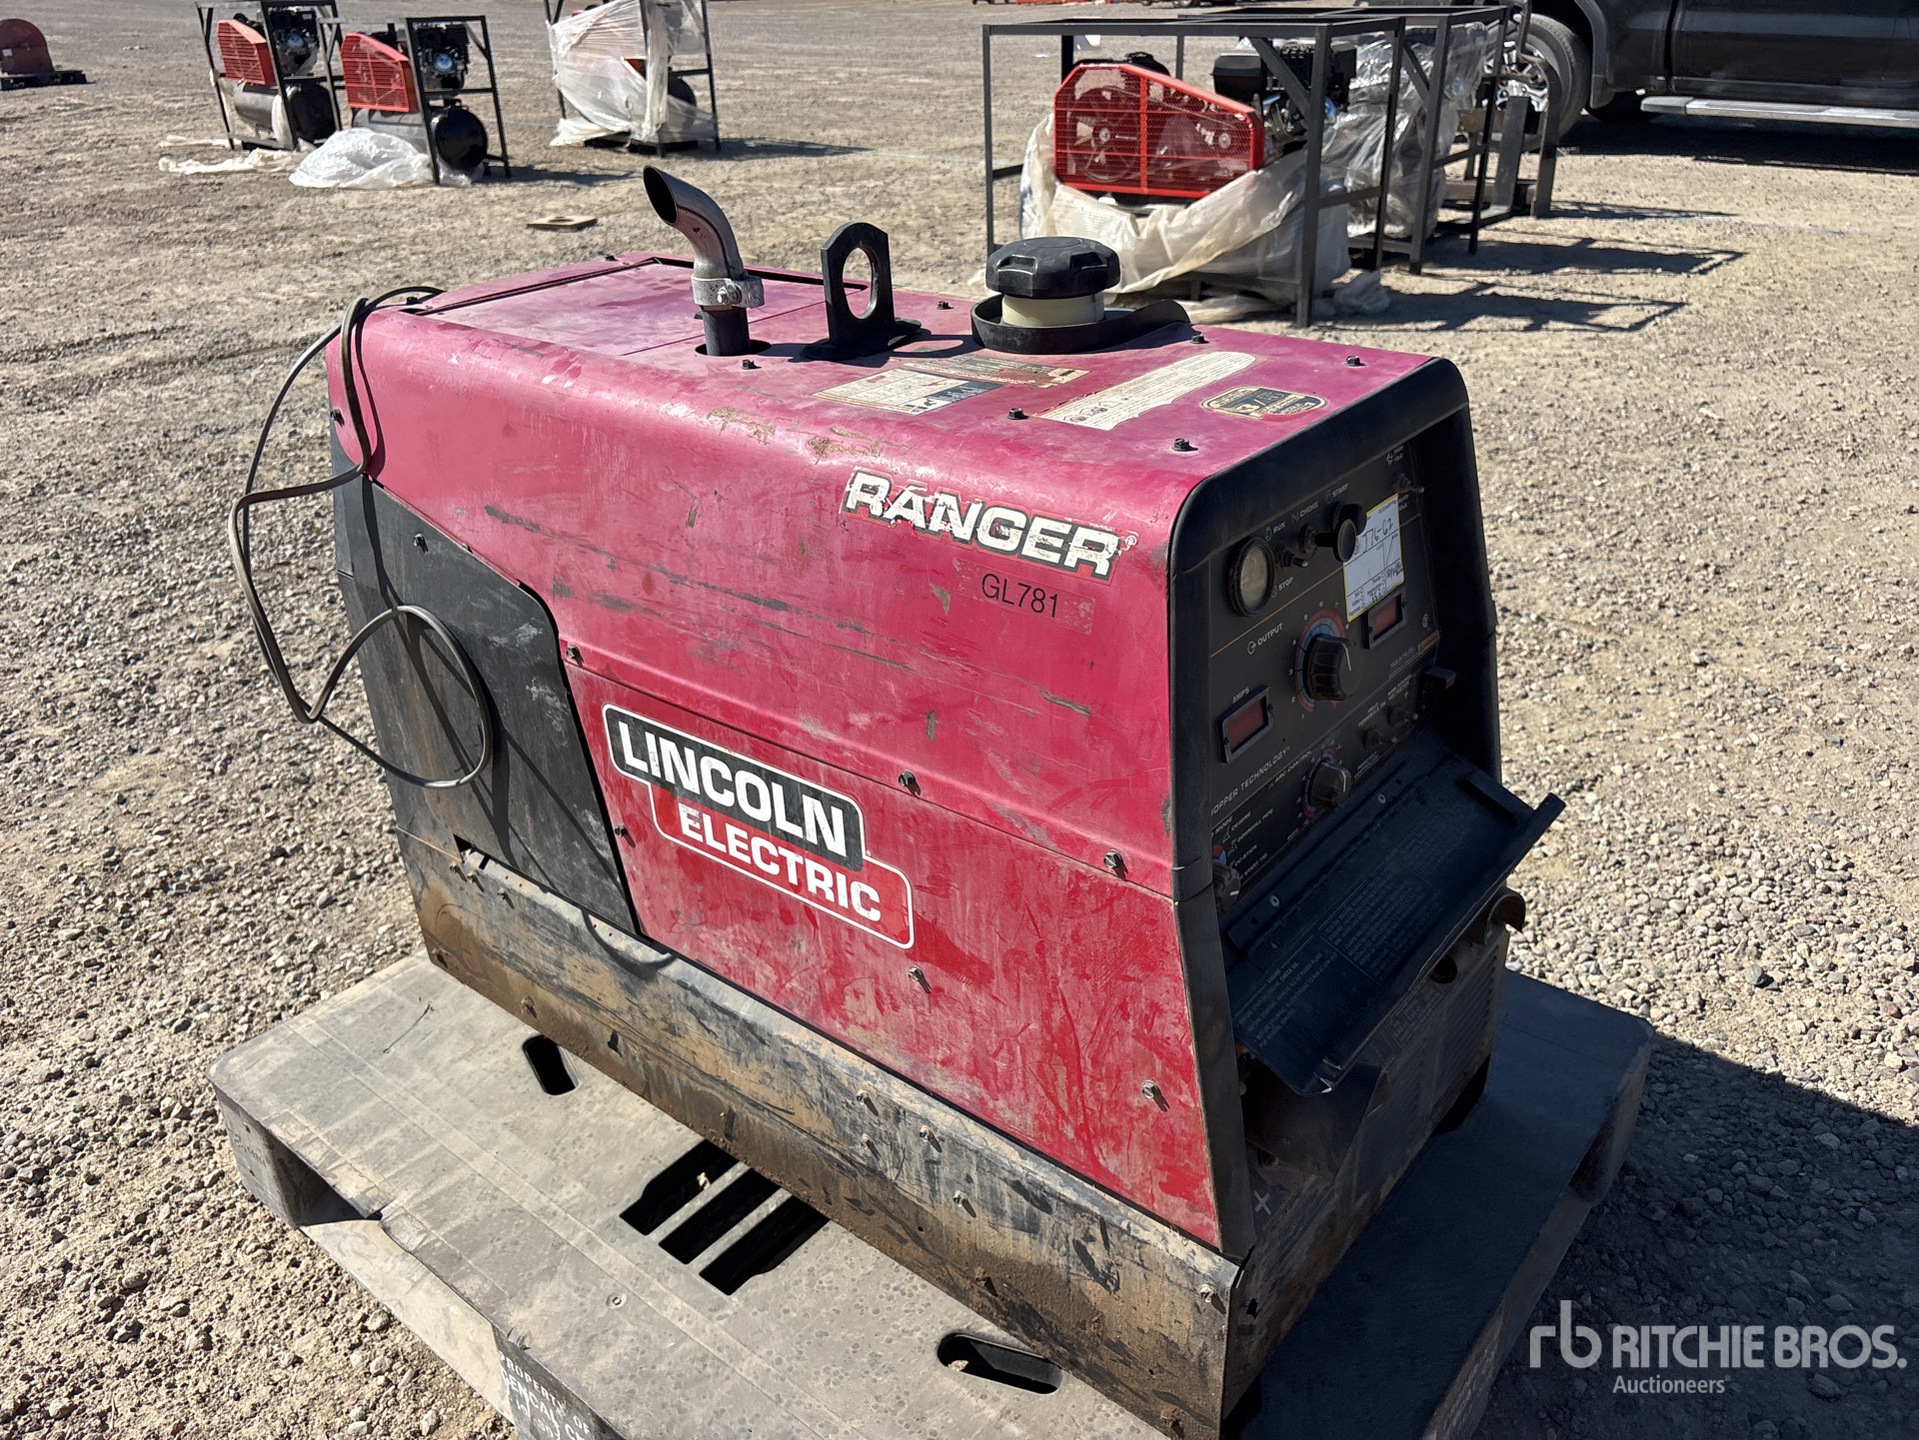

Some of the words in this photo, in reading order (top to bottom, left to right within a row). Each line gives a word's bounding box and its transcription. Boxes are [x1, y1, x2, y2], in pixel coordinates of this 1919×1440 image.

[1300, 501, 1319, 517] CHOKE
[845, 470, 1121, 577] RANGER
[1273, 521, 1286, 533] RUN
[1278, 577, 1293, 591] STOP
[981, 573, 1058, 618] GL781
[1257, 622, 1283, 646] OUTPUT
[1232, 686, 1250, 703] AMPS
[618, 721, 847, 857] LINCOLN
[678, 803, 881, 921] ELECTRIC
[573, 1415, 590, 1434] OF
